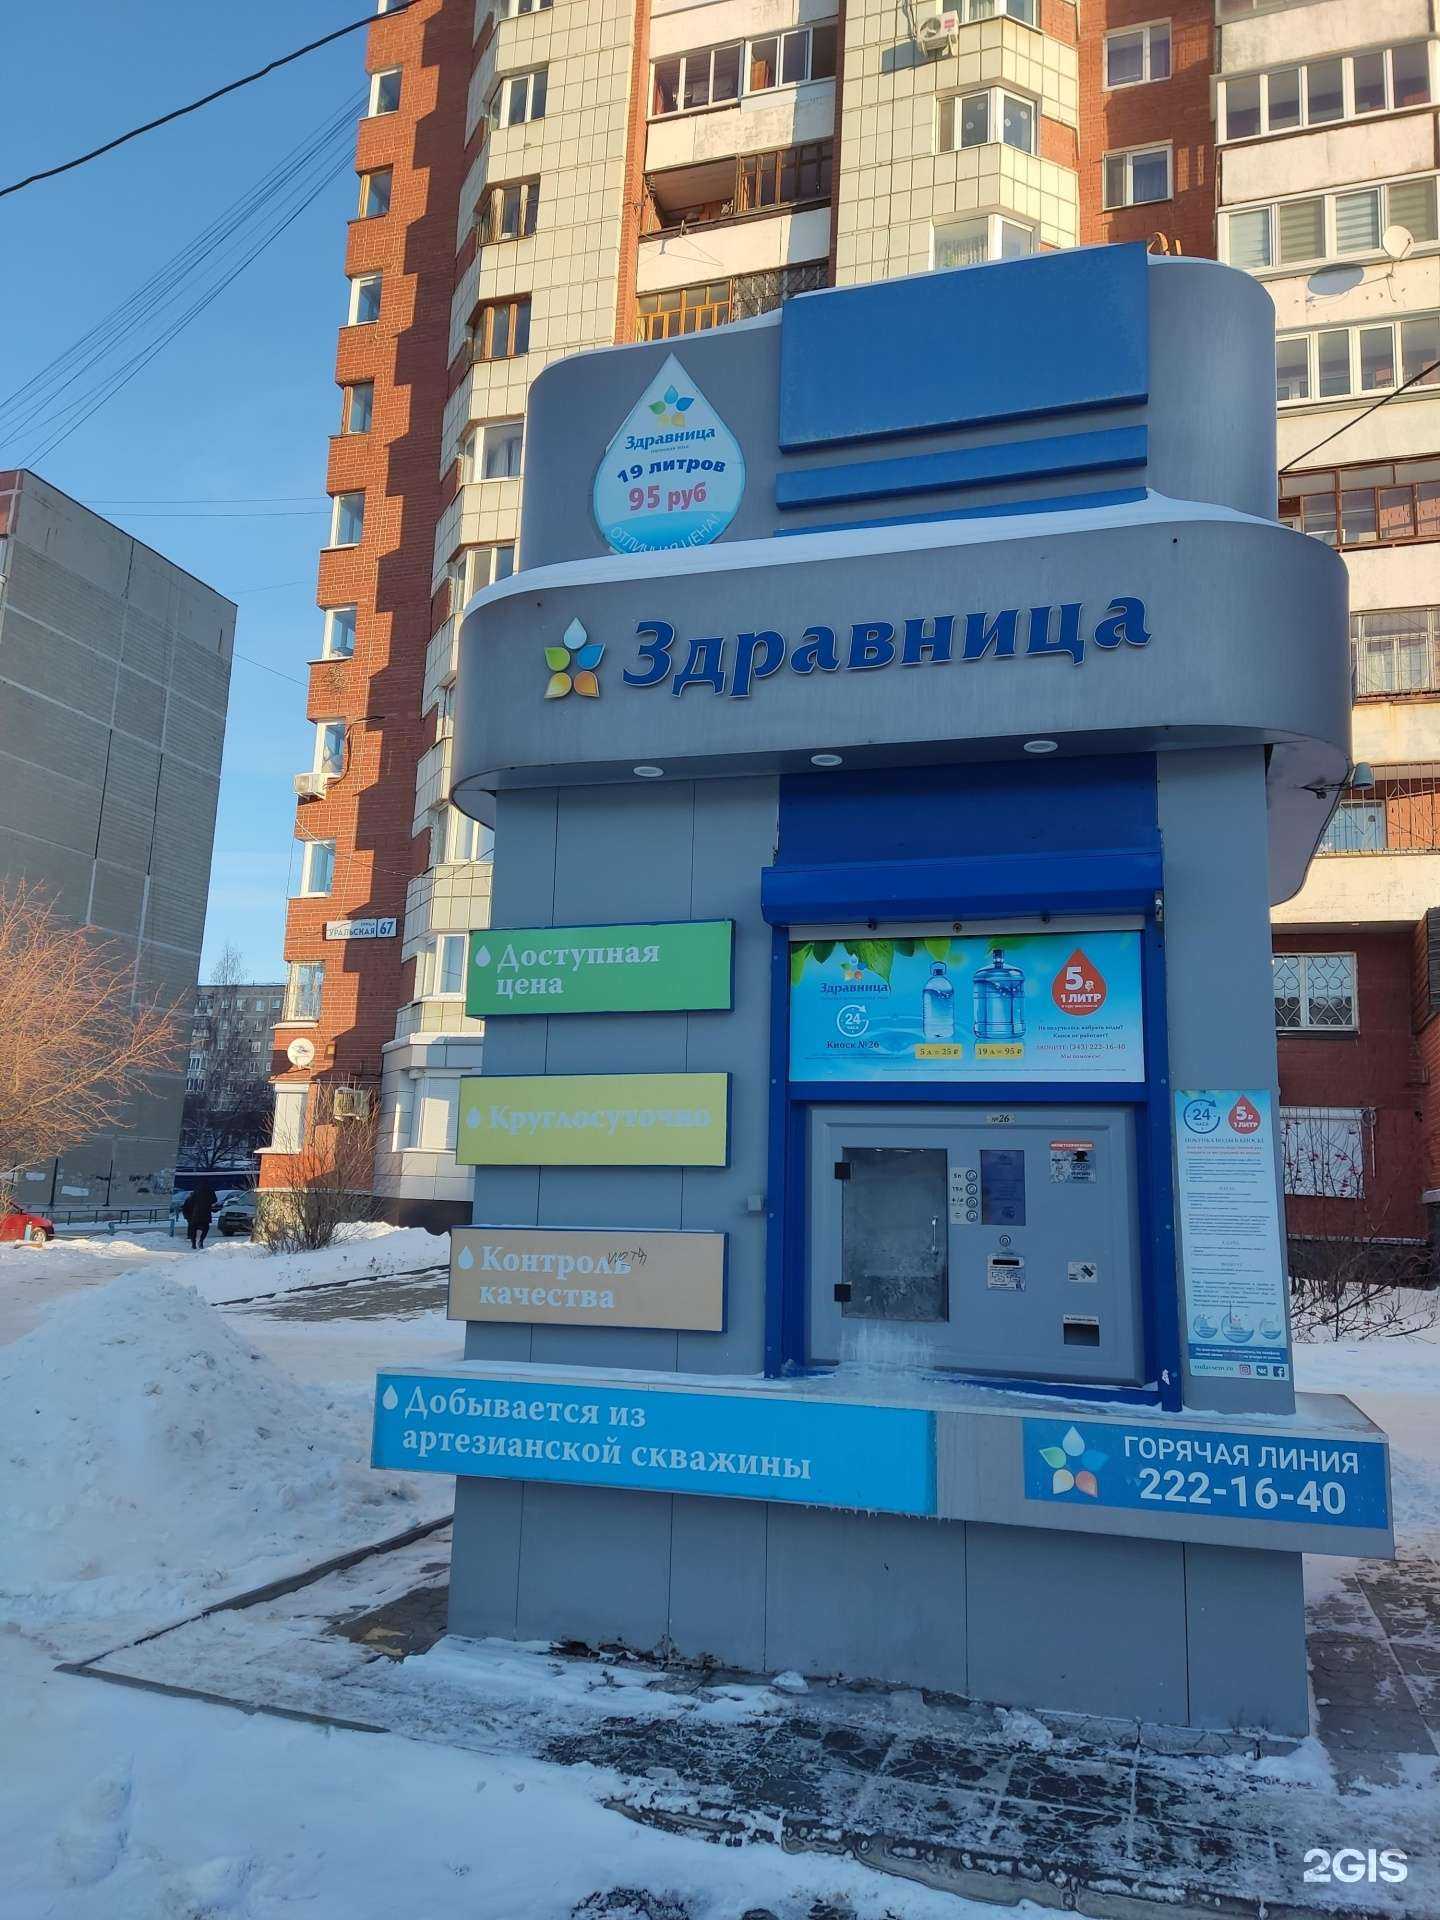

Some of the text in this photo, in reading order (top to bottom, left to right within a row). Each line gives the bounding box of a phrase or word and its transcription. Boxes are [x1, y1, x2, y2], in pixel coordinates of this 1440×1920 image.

[625, 428, 716, 451] Здравница
[617, 458, 726, 483] 19 литров
[629, 481, 707, 512] 95 руб
[622, 596, 1152, 699] Здравница
[328, 920, 394, 937] УРАЛЬСКАЯ 67
[497, 944, 660, 973] Доступная
[496, 976, 564, 1000] цена
[820, 982, 889, 996] Здравница
[1060, 993, 1101, 1003] 1 ЛИТР
[844, 1012, 861, 1025] 24
[489, 1104, 712, 1136] Круглосуточно
[1192, 1107, 1211, 1121] 24
[480, 1245, 632, 1281] Контроль
[480, 1285, 616, 1309] качества
[403, 1385, 647, 1428] Добывается из
[402, 1428, 812, 1480] артезианской скважины
[1123, 1434, 1360, 1475] ГОРЯЧАЯ ЛИНИЯ
[1138, 1467, 1347, 1516] 222-16-40
